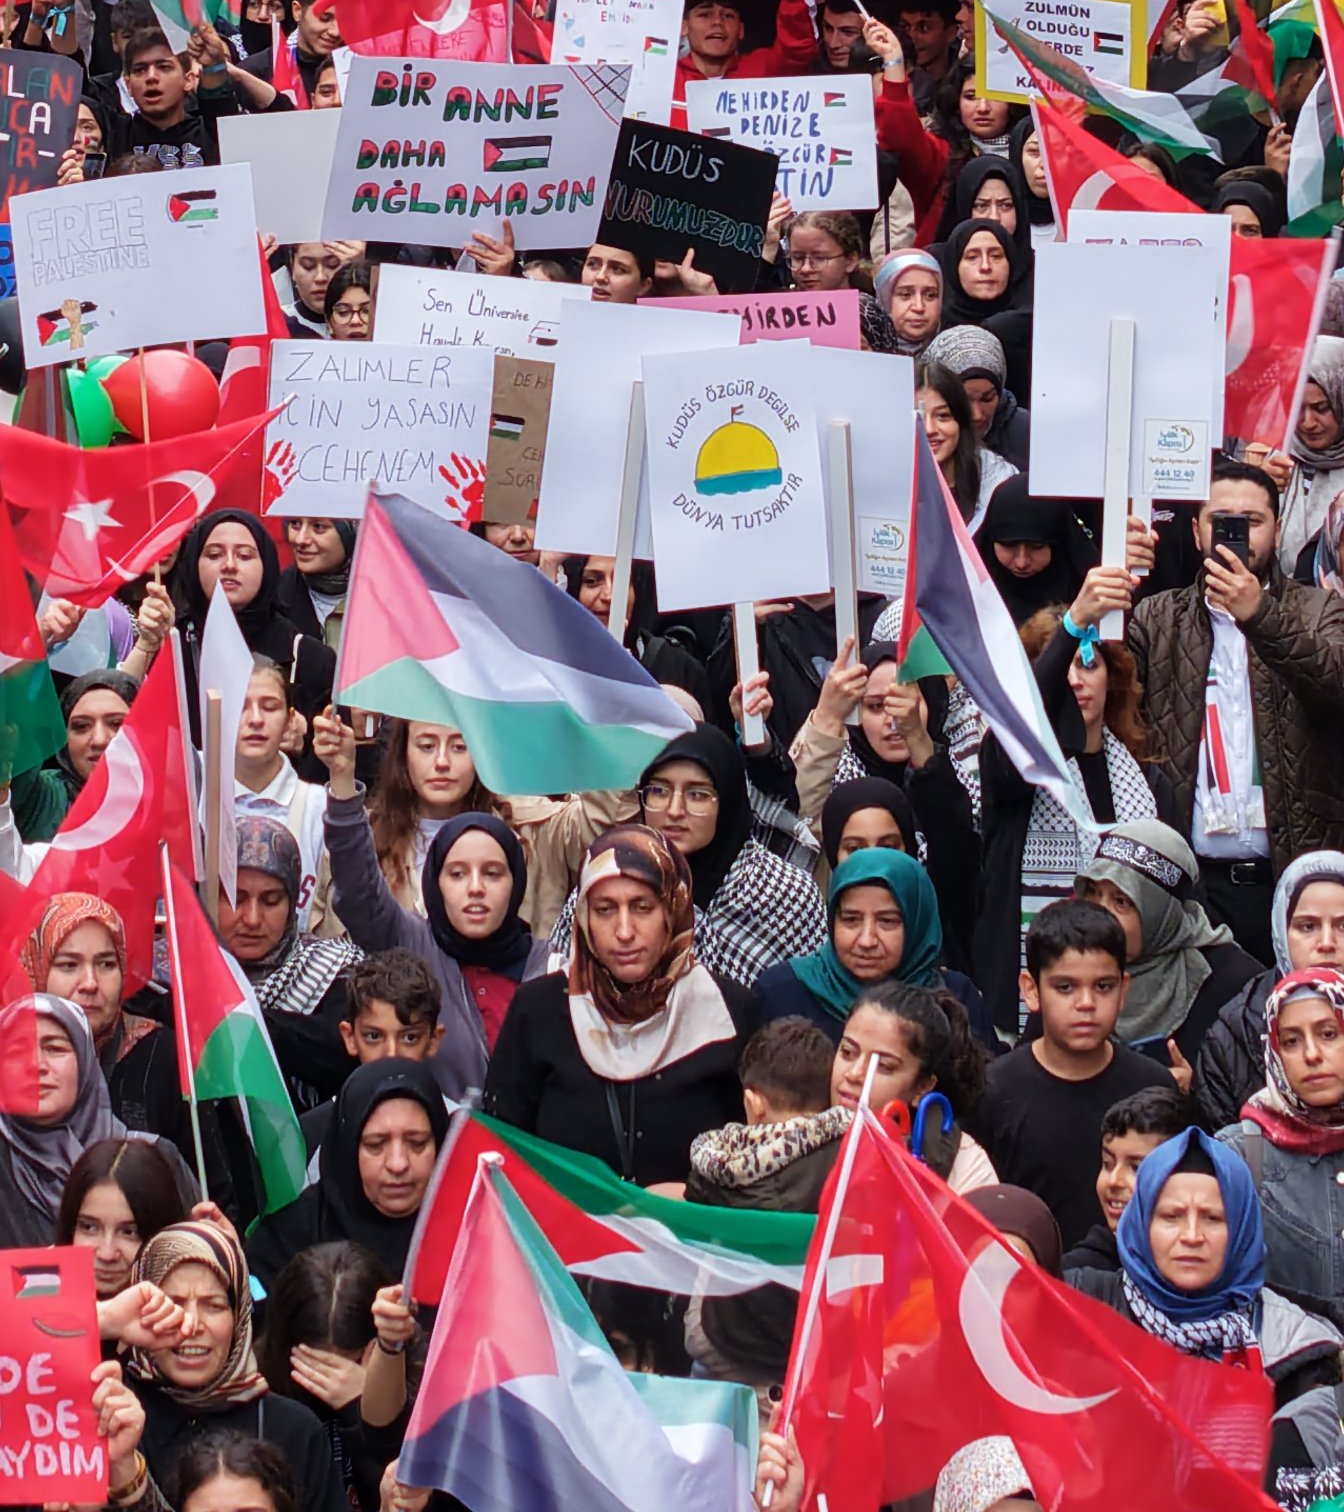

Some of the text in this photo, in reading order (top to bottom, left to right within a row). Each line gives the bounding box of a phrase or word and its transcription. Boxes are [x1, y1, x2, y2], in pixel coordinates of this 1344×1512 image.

[1025, 1, 1091, 19] ZULMÜN
[1026, 19, 1090, 38] OLDUĞU
[371, 63, 565, 123] BİR ANNE
[716, 90, 811, 114] NEHİRDEN
[741, 112, 822, 138] DENİZE
[356, 138, 446, 169] DAHA
[627, 134, 725, 183] KUDÜS
[27, 195, 146, 259] FREE
[33, 244, 150, 287] PALESTINE
[423, 288, 452, 313] Sen
[361, 398, 476, 430] YAŞASIN
[665, 396, 702, 450] KUDÜS
[705, 379, 755, 403] ÖZGÜR
[1173, 469, 1181, 477] 12
[672, 472, 804, 531] DÜNYA TUTSAKTIR
[26, 1399, 81, 1439] DE
